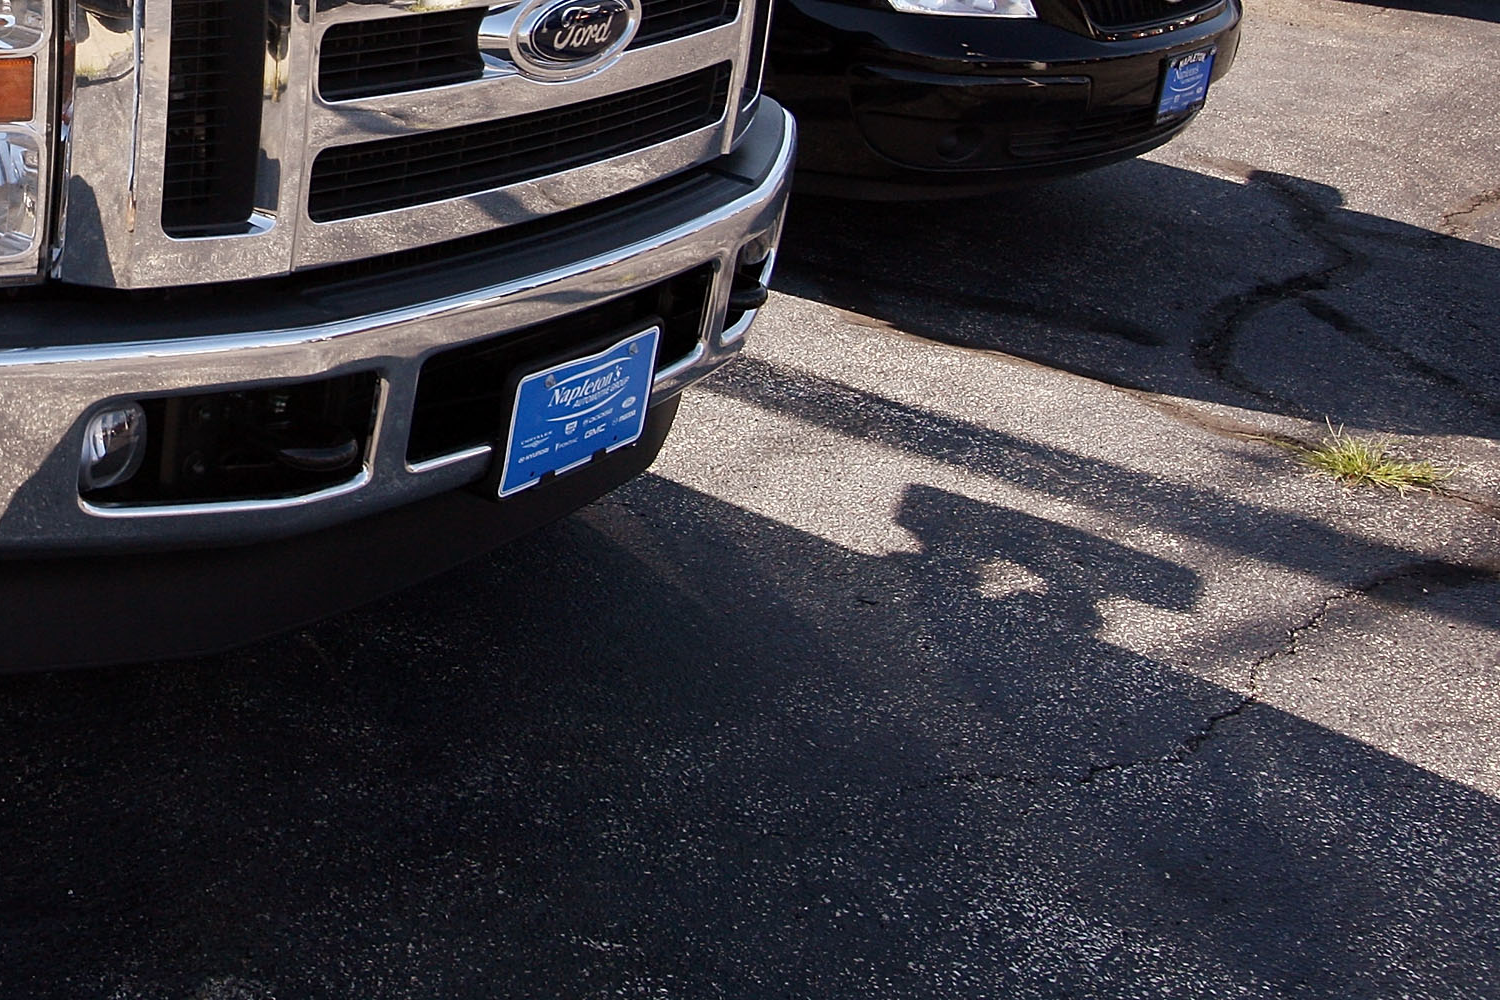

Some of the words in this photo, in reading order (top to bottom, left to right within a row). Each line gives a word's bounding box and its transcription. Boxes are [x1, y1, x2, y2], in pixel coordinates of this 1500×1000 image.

[554, 4, 615, 51] Ford
[547, 364, 623, 408] Napleton's
[584, 423, 607, 439] GMC
